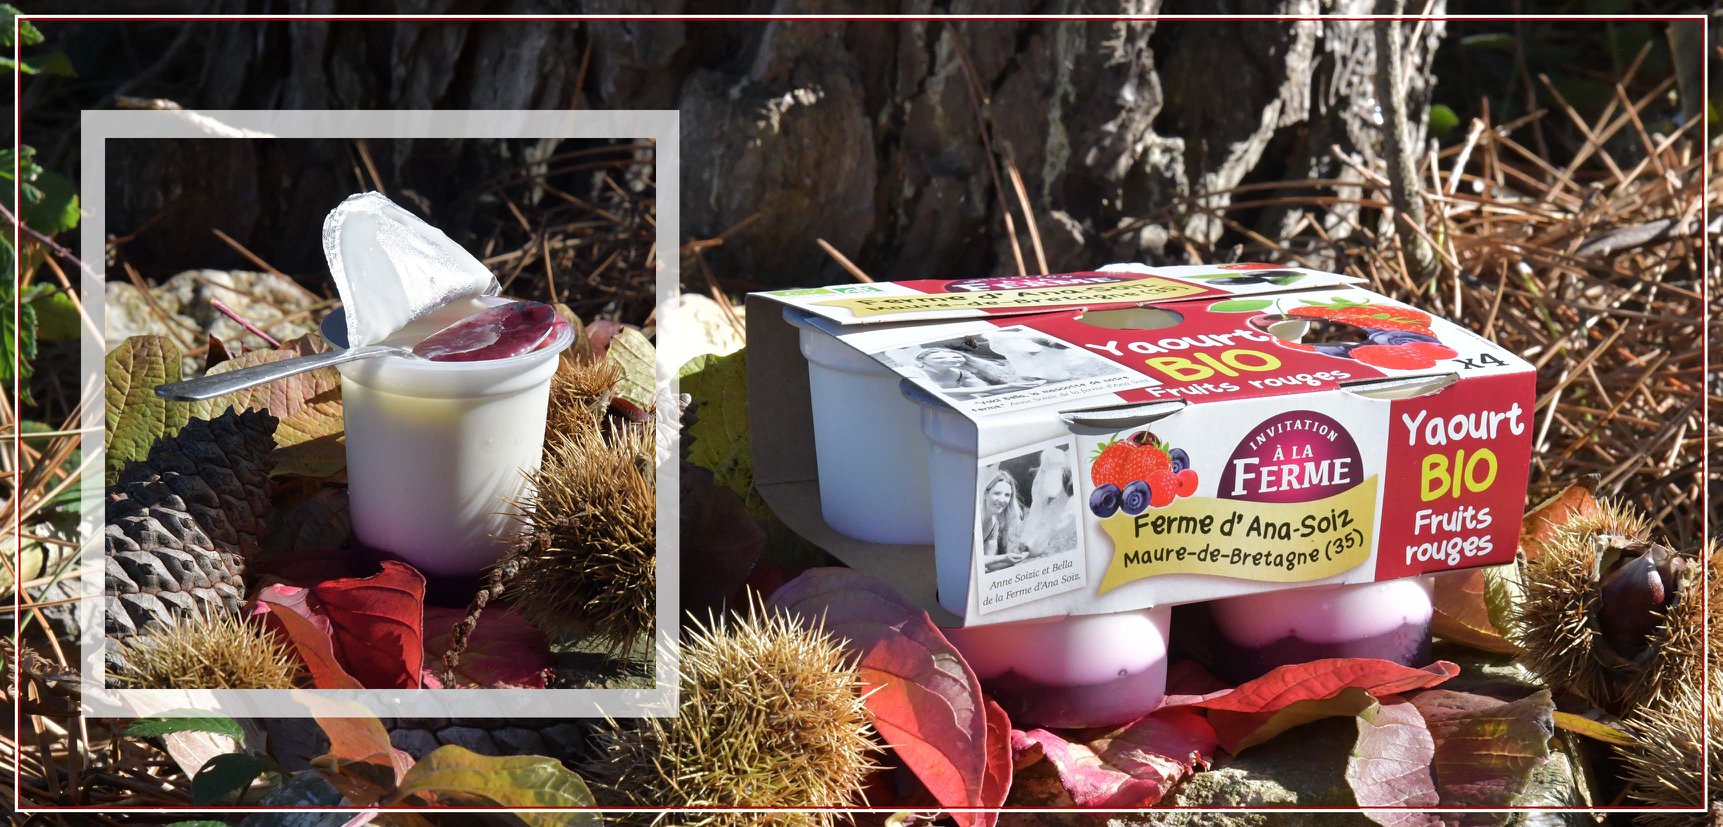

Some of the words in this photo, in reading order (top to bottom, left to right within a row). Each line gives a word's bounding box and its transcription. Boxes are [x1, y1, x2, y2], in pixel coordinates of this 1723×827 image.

[856, 295, 967, 306] Ferme
[1018, 283, 1157, 298] Ana-Soiz
[866, 291, 1140, 311] Maure-de-Bretagne
[1084, 328, 1270, 356] Yaourt
[1145, 348, 1281, 381] BIO
[1145, 380, 1240, 398] Fruits
[1248, 368, 1351, 388] rouges
[1249, 419, 1338, 451] INVITATION
[1401, 402, 1525, 446] Yaourt
[1272, 444, 1285, 461] À
[1291, 444, 1314, 460] LA
[1231, 457, 1352, 496] FERME
[1420, 448, 1498, 502] BIO
[1134, 512, 1215, 538] Ferme
[1414, 505, 1492, 536] Fruits
[1124, 543, 1320, 571] Maure-de-Bretagne
[1325, 528, 1364, 561] (35)
[1405, 534, 1494, 566] rouges
[989, 577, 1013, 590] Anne
[1015, 569, 1040, 583] Soizic
[1041, 566, 1050, 575] et
[1052, 560, 1073, 573] Bella
[982, 596, 993, 606] de
[995, 594, 1004, 603] la
[1005, 586, 1032, 600] Ferme
[1034, 578, 1059, 592] d'Ana
